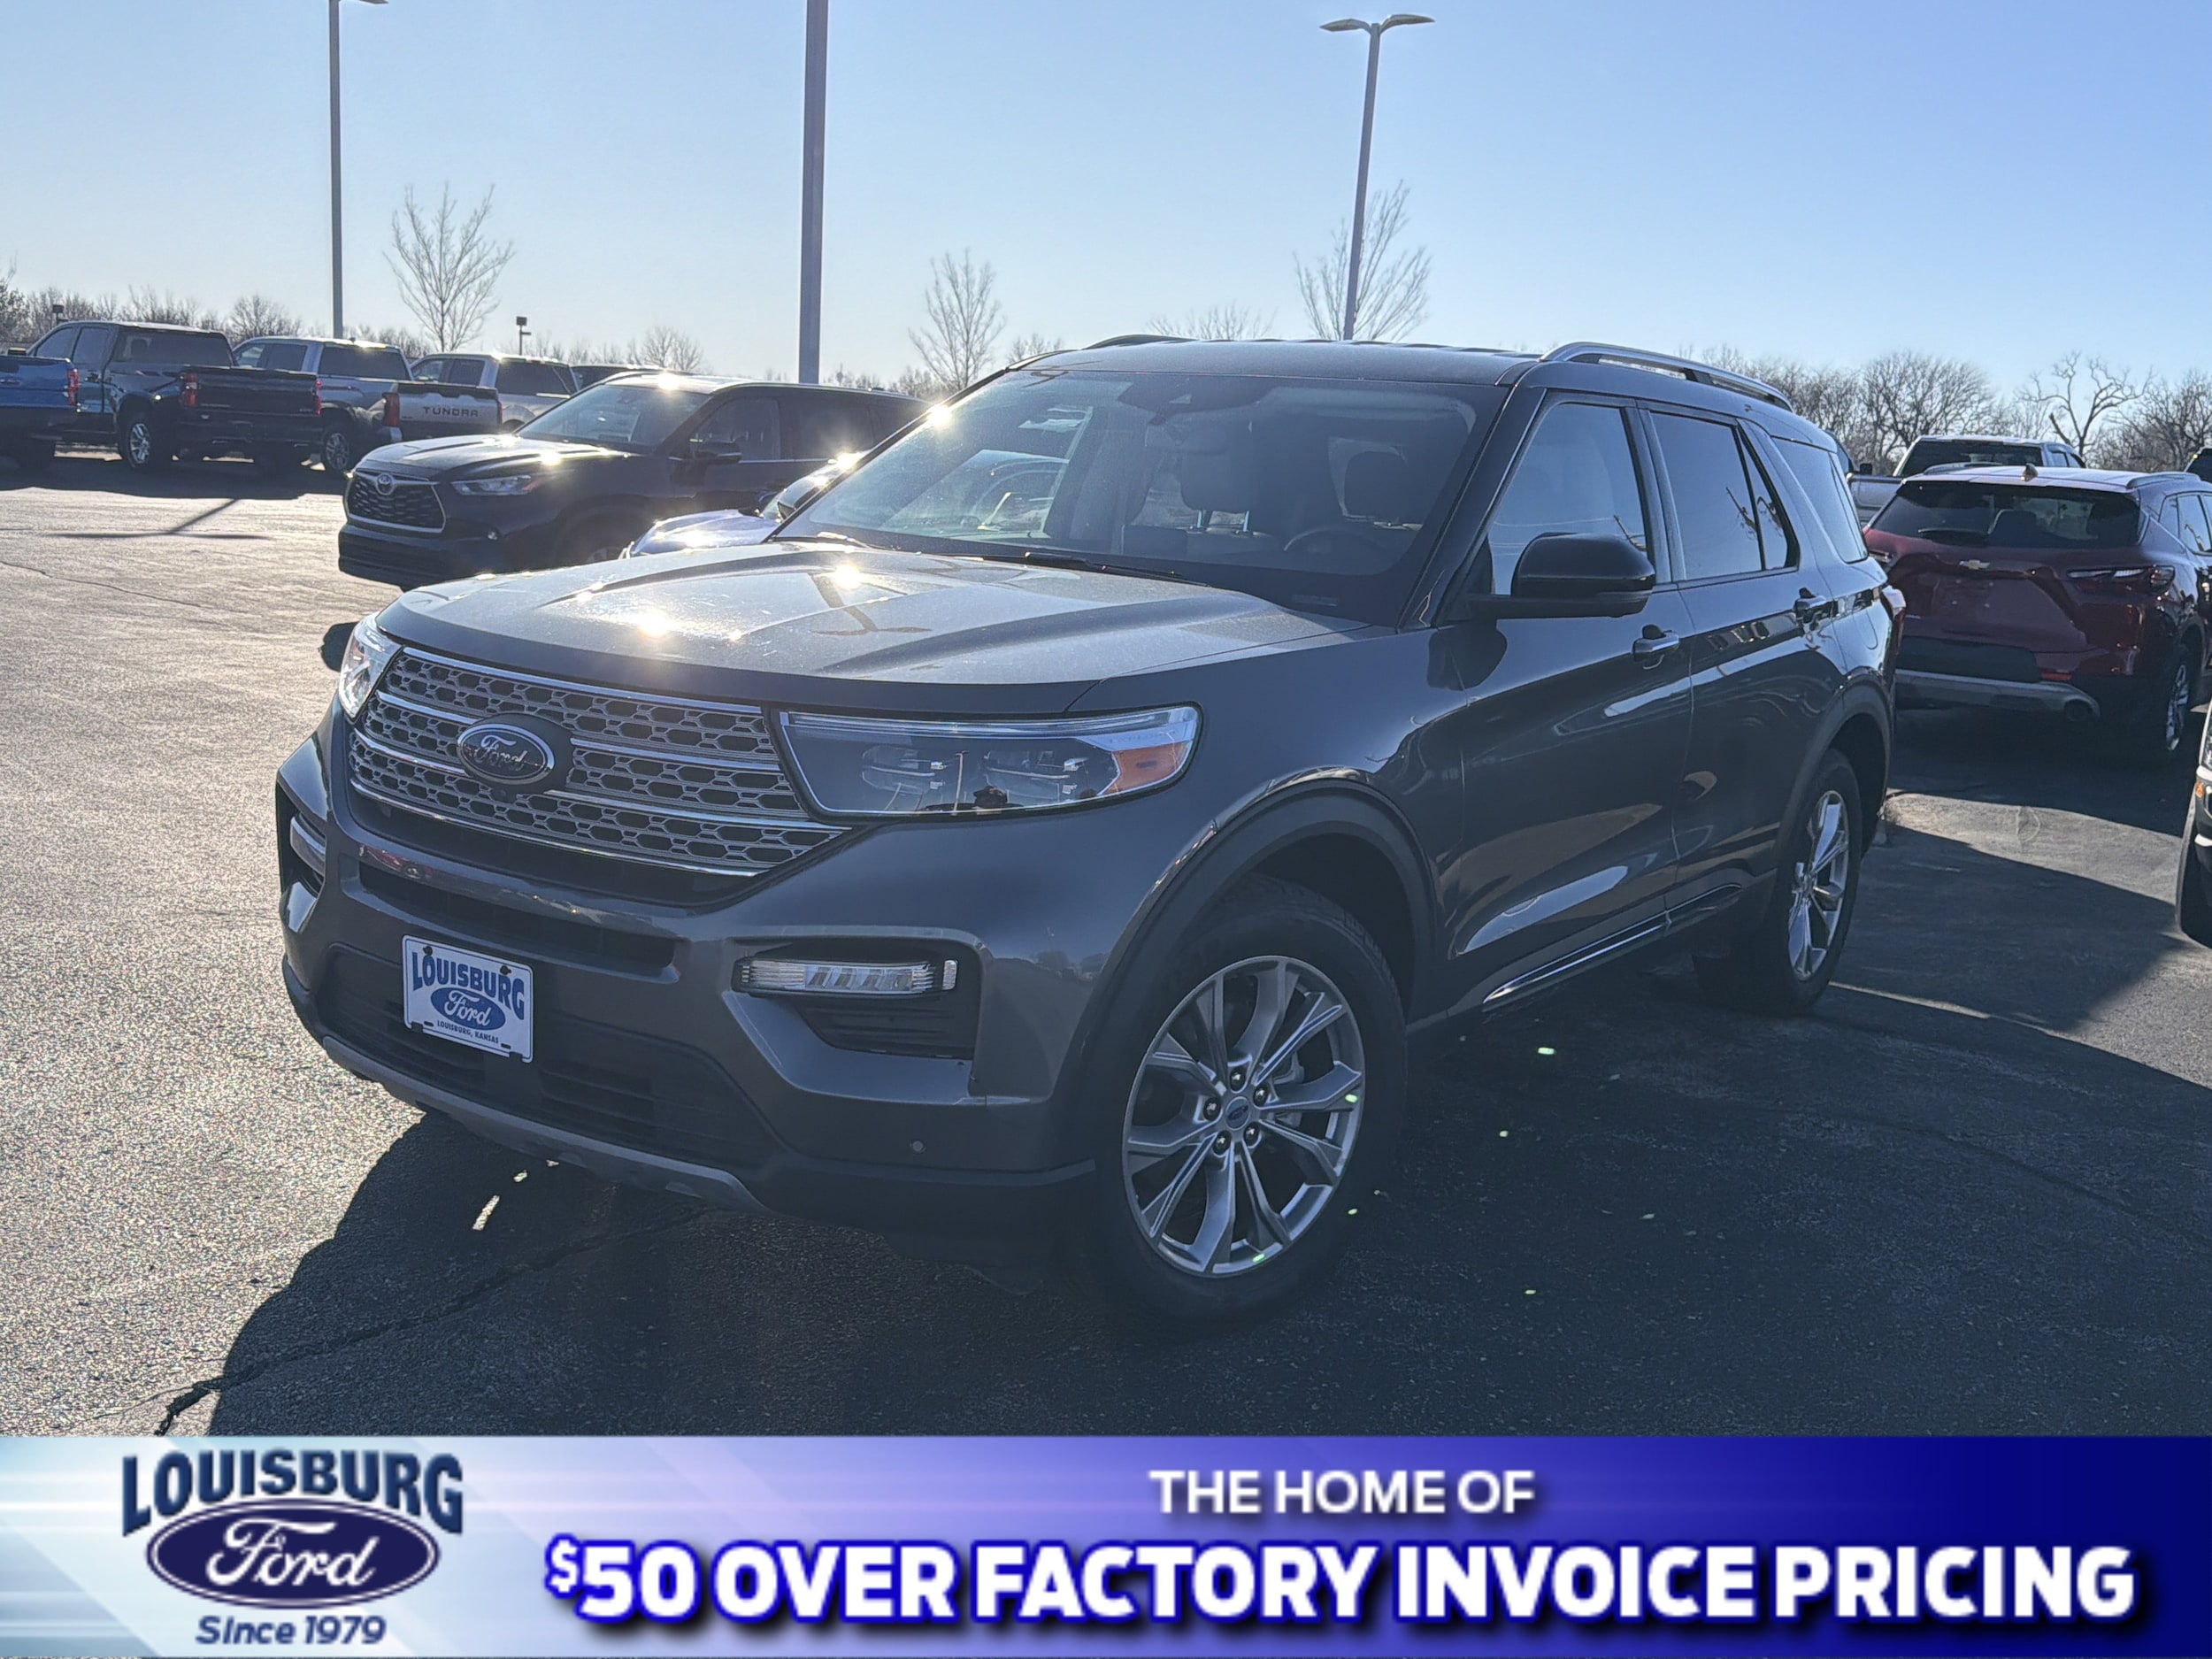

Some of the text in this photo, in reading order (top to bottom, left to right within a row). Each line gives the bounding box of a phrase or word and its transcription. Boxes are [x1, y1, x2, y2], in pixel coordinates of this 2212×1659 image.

[424, 406, 479, 418] TUNDRA
[473, 733, 528, 772] Ford
[411, 951, 526, 1020] LOUISBURG
[443, 989, 492, 1026] Ford
[437, 1019, 500, 1044] LOUISBURG, KANSAS
